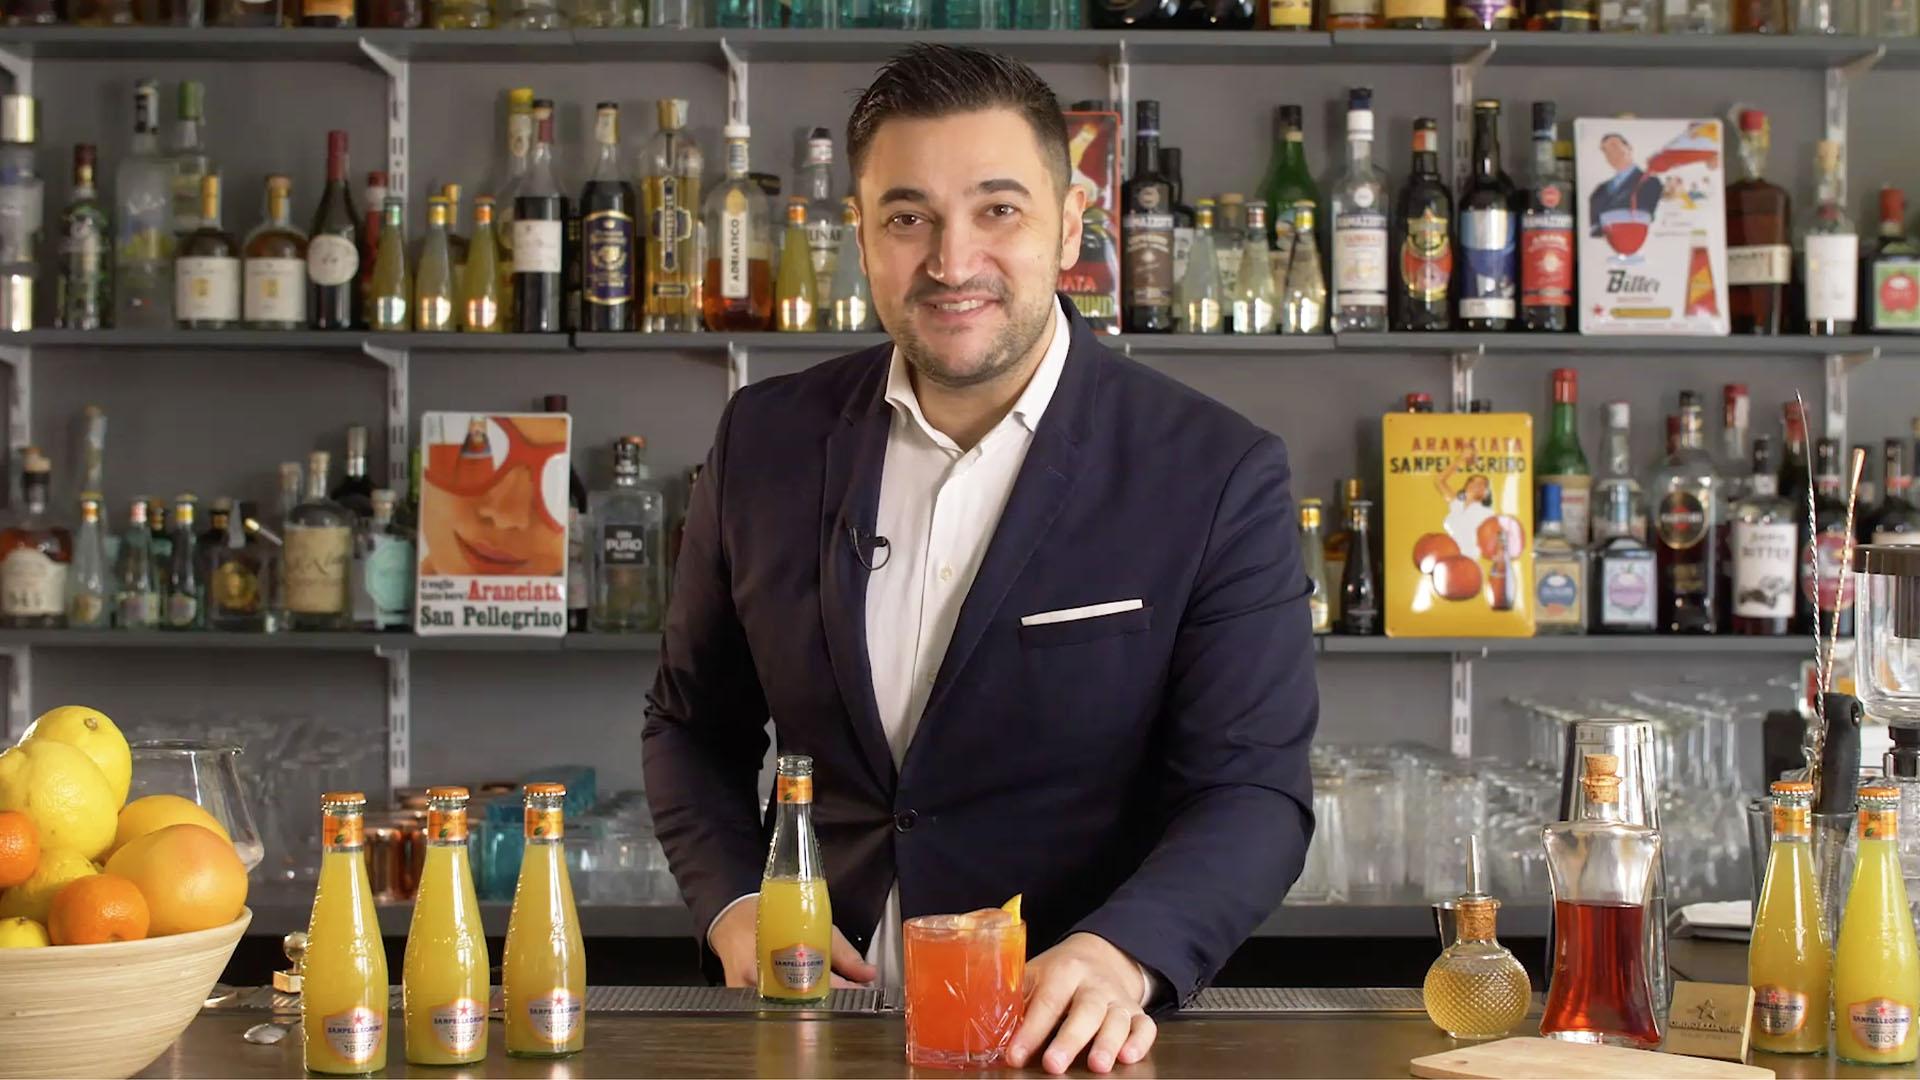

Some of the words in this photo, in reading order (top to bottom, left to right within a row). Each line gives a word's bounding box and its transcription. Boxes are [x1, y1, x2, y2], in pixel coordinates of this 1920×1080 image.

[730, 219, 740, 281] ADRIATICO
[1390, 457, 1526, 473] SANPELEGRINO
[606, 538, 643, 552] PURO
[468, 580, 562, 601] Aranciata
[420, 606, 454, 626] San
[463, 606, 562, 629] Pellegrino
